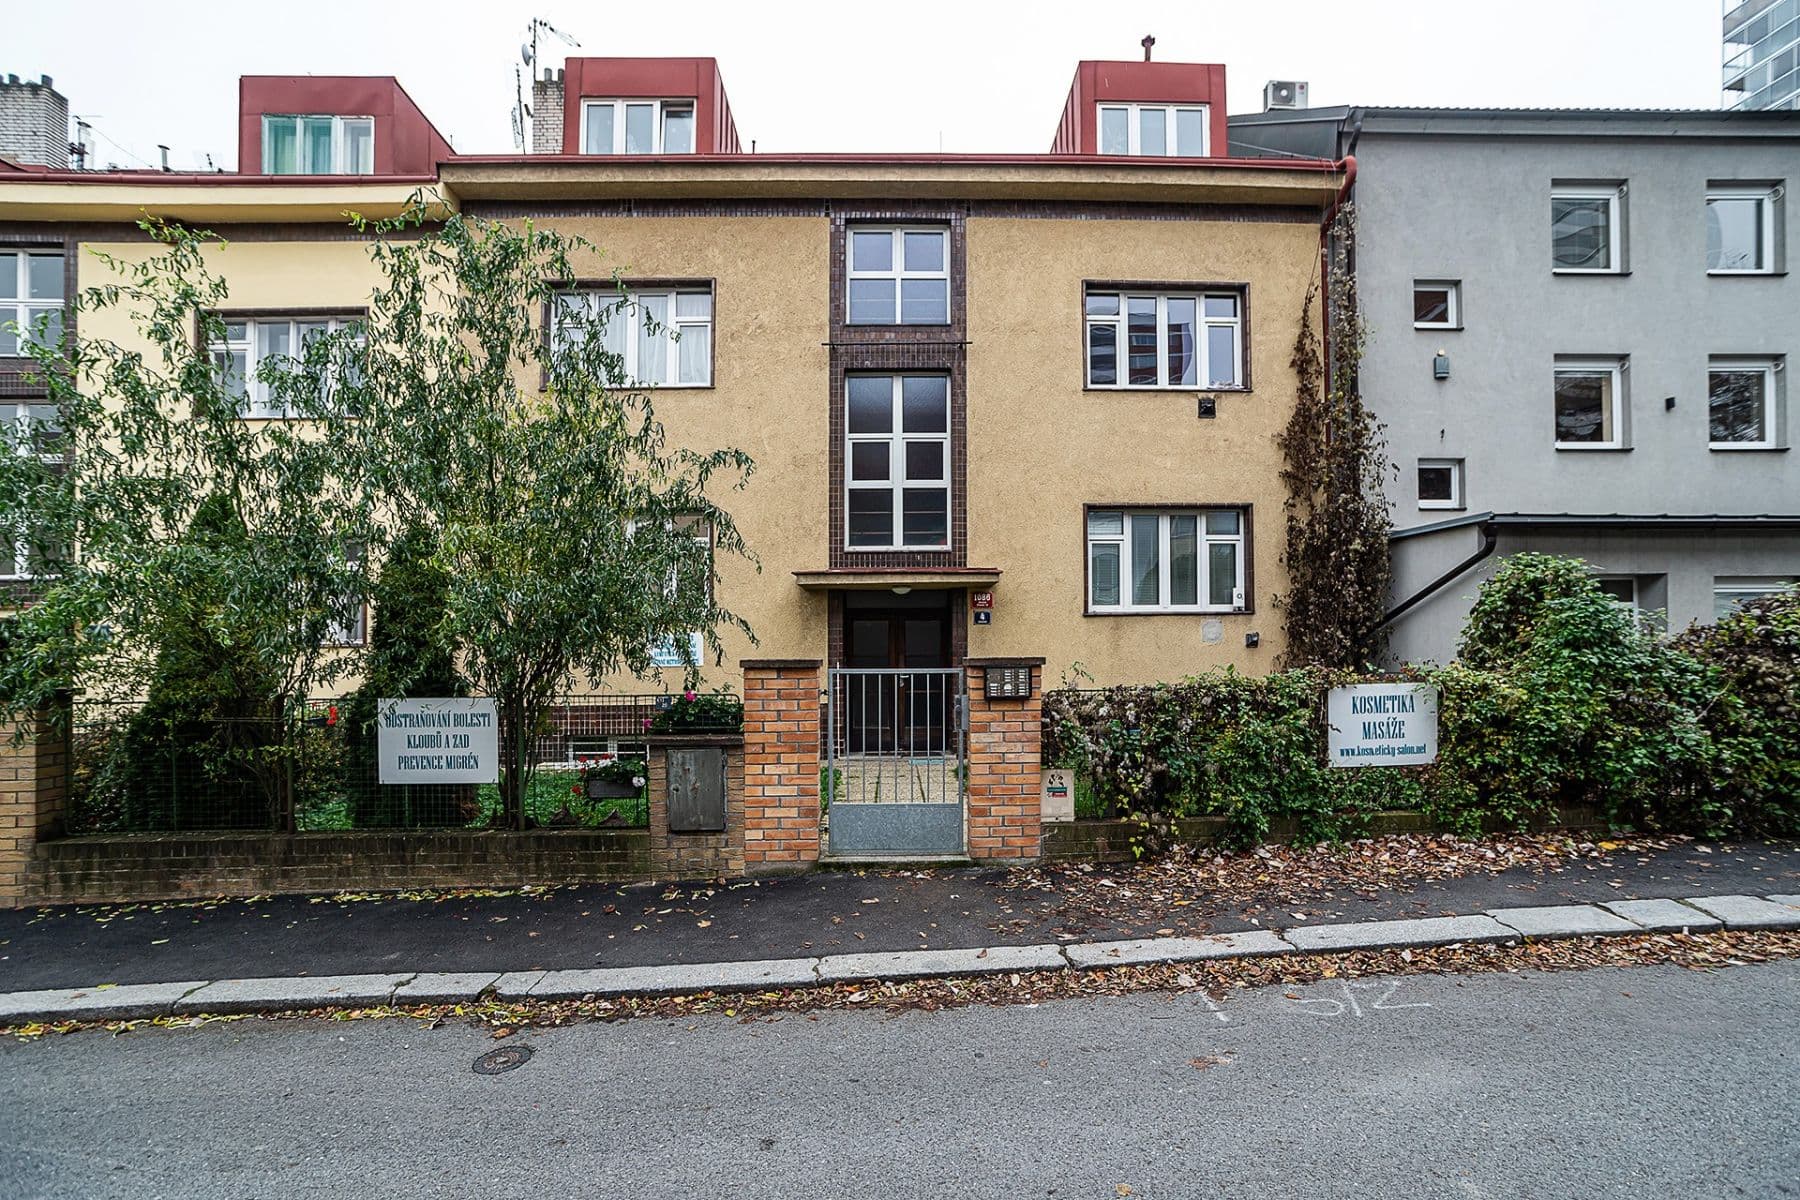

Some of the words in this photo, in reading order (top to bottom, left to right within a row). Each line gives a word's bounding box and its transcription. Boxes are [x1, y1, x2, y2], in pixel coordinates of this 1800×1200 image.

[1351, 694, 1415, 714] KOSMETIKA
[453, 712, 491, 728] BOLESTI
[1362, 717, 1405, 740] MASÁŽE
[407, 731, 442, 749] KLOUBŮ
[444, 734, 450, 749] A
[452, 734, 470, 749] ZAD
[398, 754, 443, 770] PREVENCE
[445, 751, 479, 770] MIGRÉN
